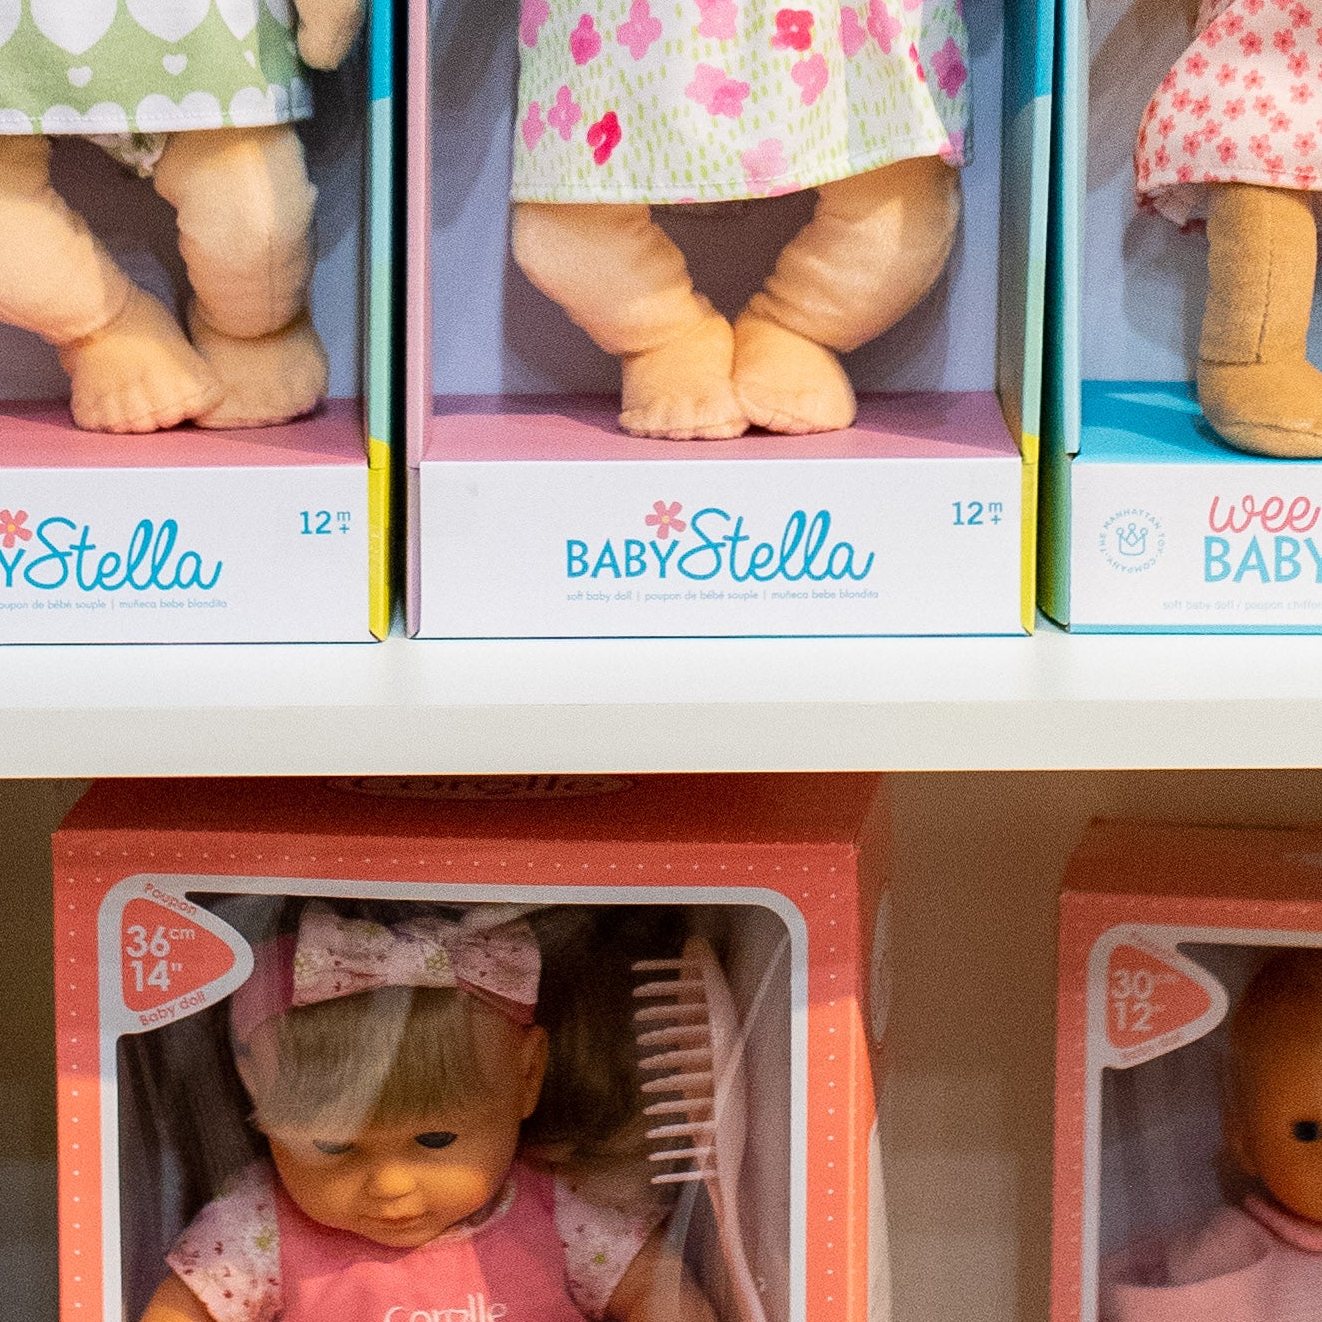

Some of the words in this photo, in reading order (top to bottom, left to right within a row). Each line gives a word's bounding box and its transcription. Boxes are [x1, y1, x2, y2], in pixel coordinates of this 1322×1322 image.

[1208, 494, 1321, 534] wee
[144, 882, 196, 915] Poupon
[139, 1006, 176, 1026] Baby
